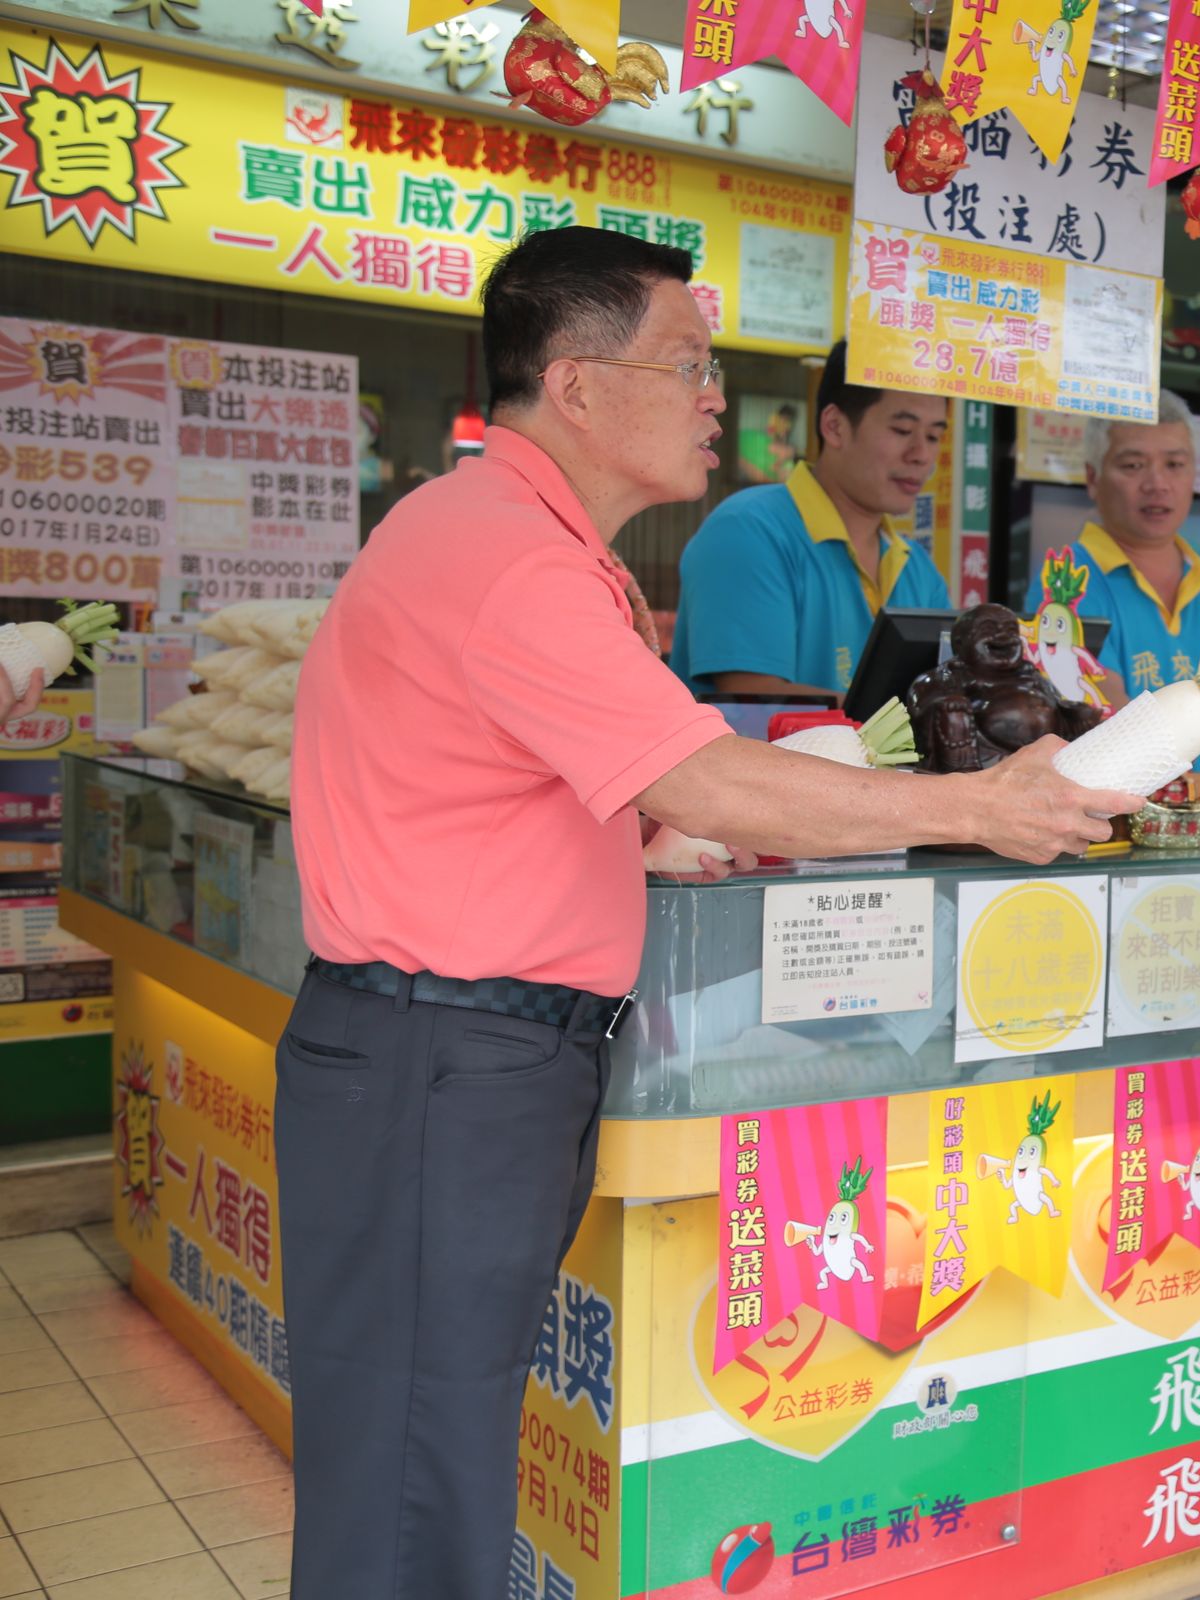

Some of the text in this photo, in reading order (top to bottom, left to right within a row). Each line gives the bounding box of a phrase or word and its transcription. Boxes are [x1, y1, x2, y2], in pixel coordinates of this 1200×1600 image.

[945, 0, 998, 117] 中大獎
[893, 72, 1146, 190] 腦券
[1159, 39, 1200, 163] 送菜頭
[24, 86, 141, 205] 賀
[350, 98, 603, 193] 飛來發彩券行
[240, 143, 371, 218] 賣出
[399, 174, 577, 240] 威力彩
[924, 182, 1106, 263] (投注處)
[212, 228, 473, 297] 一人獨得
[864, 236, 910, 293] 賀
[927, 269, 1041, 314] 賣出 威力彩
[880, 298, 1052, 352] 頭獎 一人獨得
[41, 339, 86, 385] 賀
[224, 352, 350, 394] 本投注站
[912, 339, 1018, 384] 28.7億
[0, 406, 161, 446] 投注站賣出
[0, 517, 161, 547] 017年1月24日)
[816, 892, 884, 912] 貼心提醒
[1005, 909, 1065, 945] 未滿
[1151, 894, 1195, 924] 拒賣
[973, 952, 1091, 992] 十八歲者
[944, 1096, 965, 1174] 好彩頭
[1126, 1071, 1145, 1146] 買彩券
[736, 1119, 761, 1204] 買彩券
[165, 1151, 270, 1284] 一人獨得
[930, 1178, 969, 1297] 中大獎
[1114, 1148, 1149, 1256] 送菜頭
[725, 1206, 766, 1330] 送菜頭
[773, 1377, 875, 1422] 公益彩券
[892, 1404, 979, 1440] 財政部關心您
[791, 1493, 967, 1576] 台灣彩券
